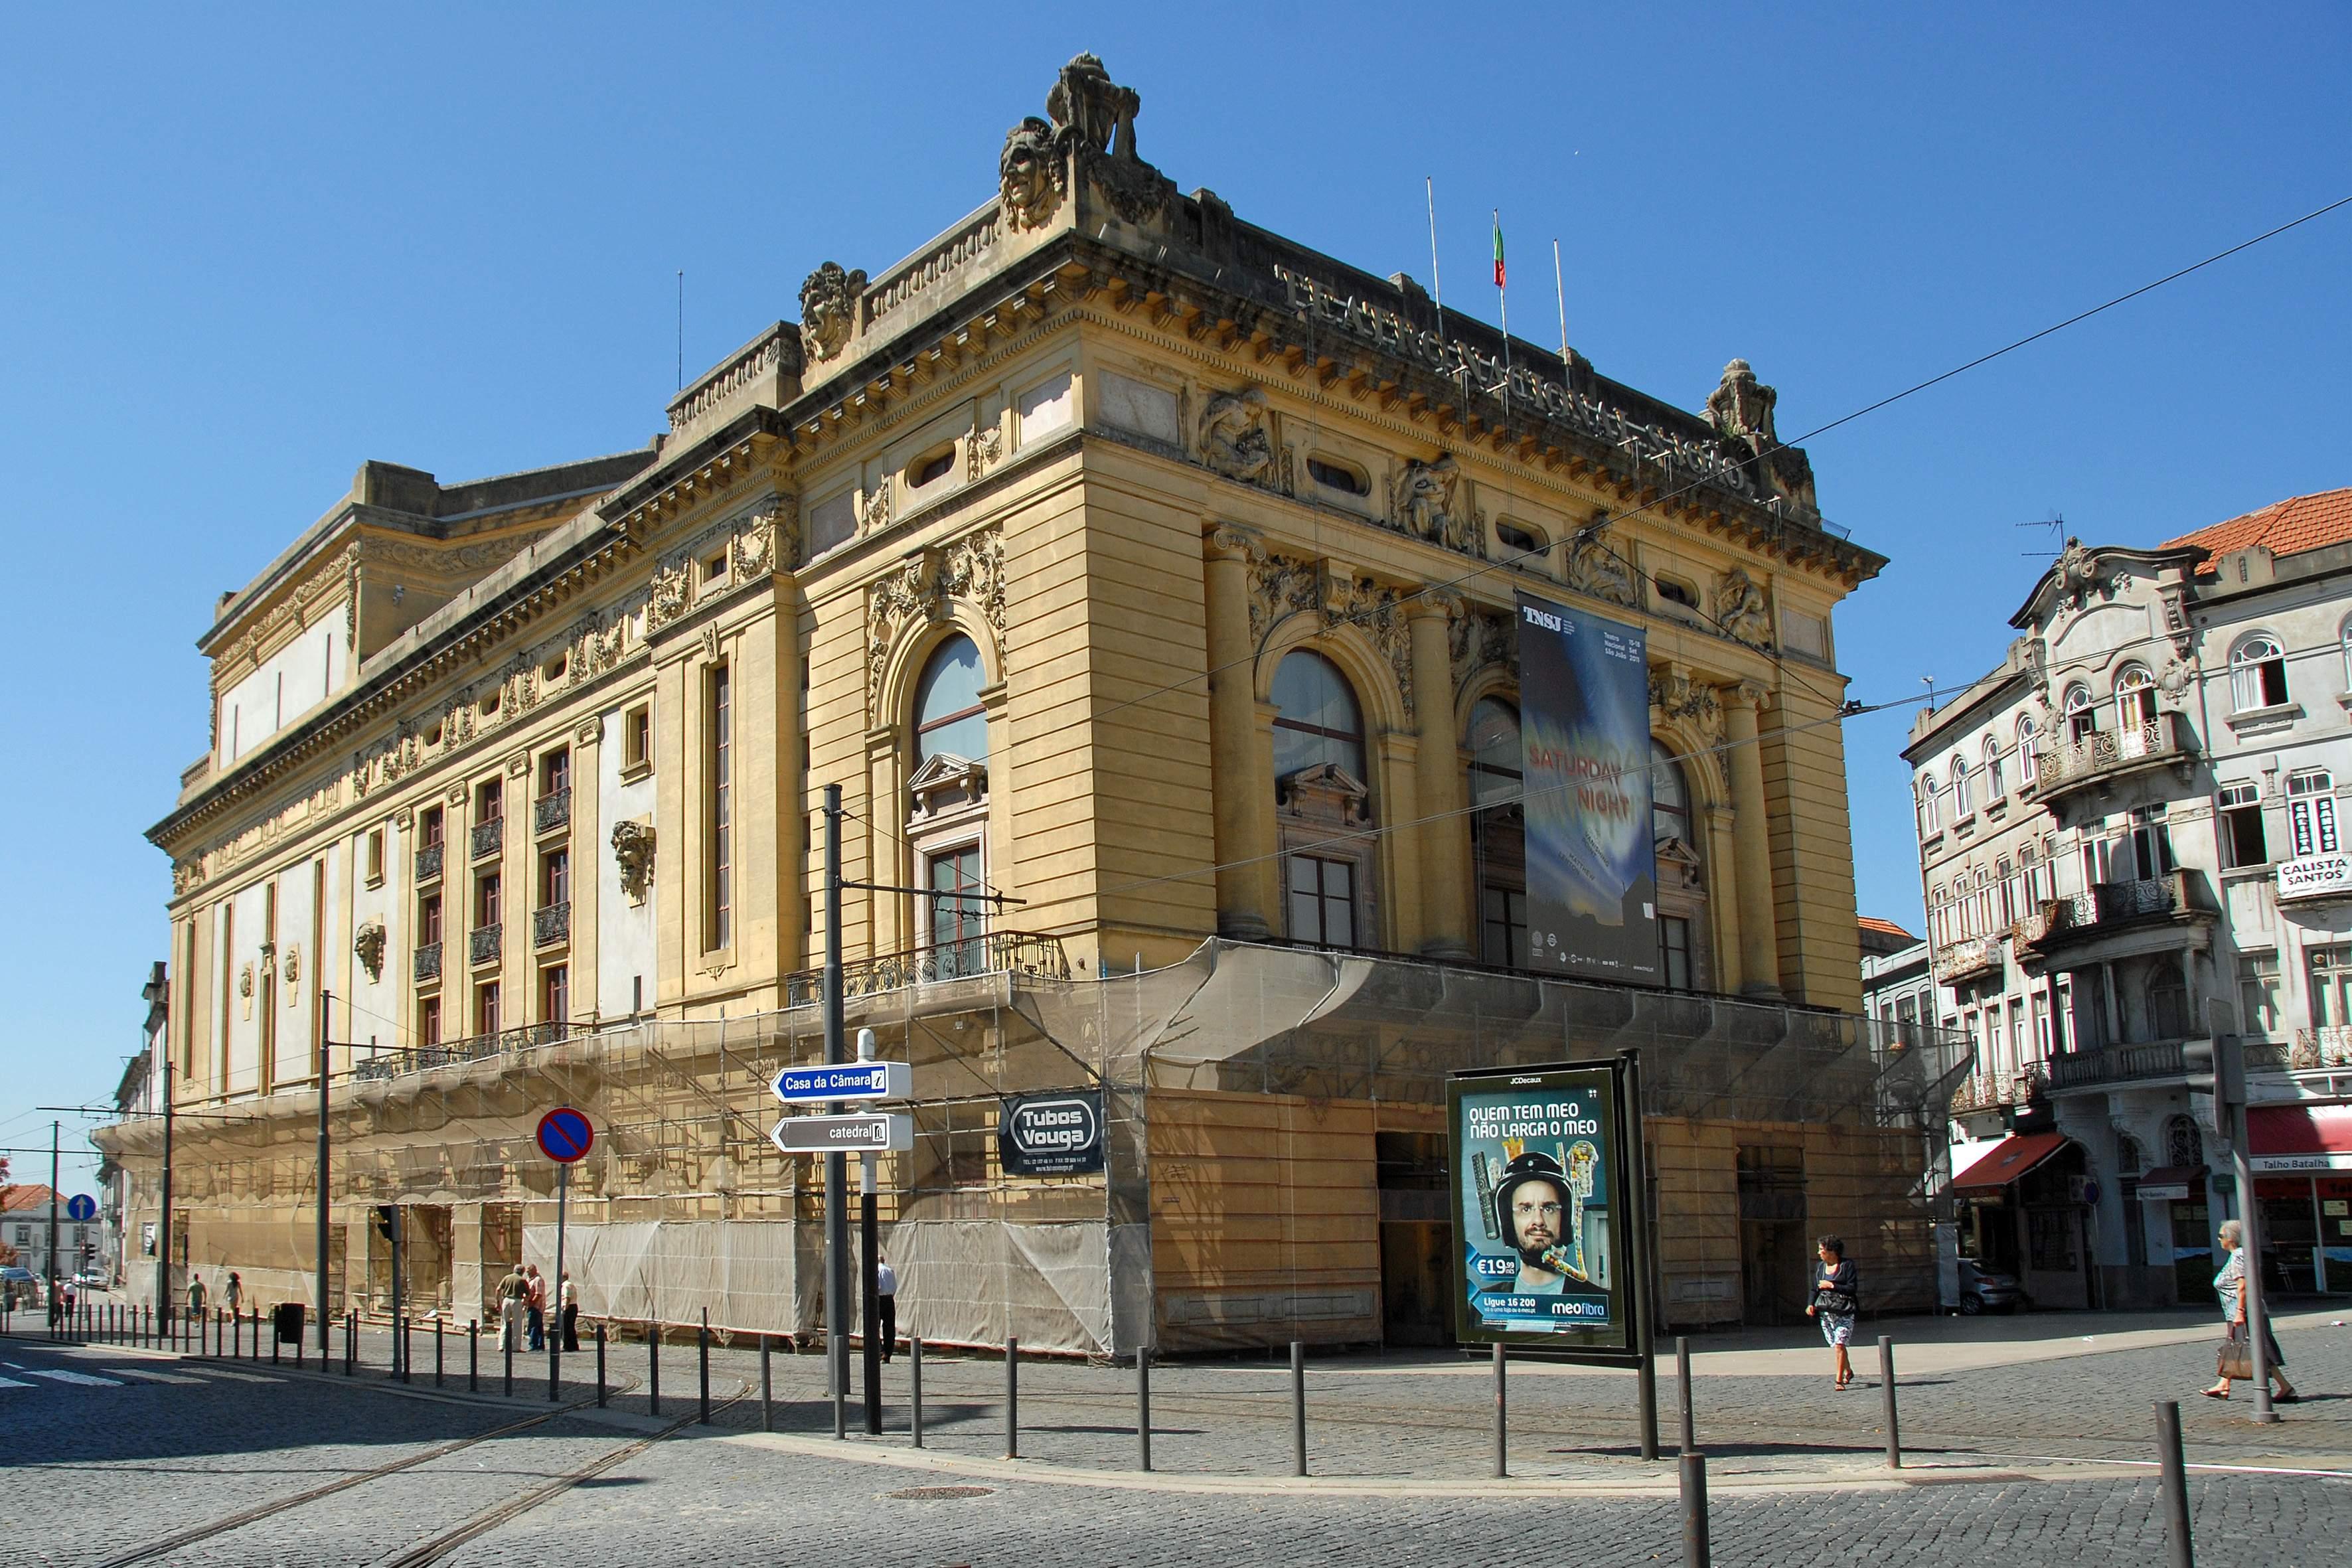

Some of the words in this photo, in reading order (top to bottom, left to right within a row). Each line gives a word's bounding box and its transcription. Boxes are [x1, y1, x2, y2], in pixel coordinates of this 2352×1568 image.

[1273, 264, 1449, 366] TEATRO
[1452, 339, 1637, 449] NACIONAL
[1523, 605, 1561, 632] TNSJ
[1604, 632, 1620, 642] Teatro
[1604, 640, 1626, 651] Nacional
[1529, 744, 1621, 785] SATURDAY
[1578, 787, 1630, 821] NIGHT
[2295, 805, 2312, 853] CALISTA
[2319, 801, 2335, 849] SANTOS
[2282, 859, 2348, 875] CALISTA
[2288, 870, 2343, 885] SANTOS
[785, 1077, 811, 1090] Casa
[814, 1075, 826, 1088] da
[830, 1074, 871, 1087] Câmara
[1022, 1109, 1083, 1127] Tubos
[1469, 1106, 1510, 1124] QUEM
[1512, 1105, 1543, 1119] TEM
[1546, 1103, 1579, 1118] MEO
[830, 1125, 872, 1138] catedral
[1470, 1121, 1498, 1138] NÃO
[1502, 1122, 1547, 1137] LARGA
[1550, 1121, 1560, 1136] O
[1564, 1119, 1597, 1135] MEO
[1022, 1129, 1083, 1148] Vouga
[1484, 1297, 1506, 1307] Ligue
[1508, 1298, 1518, 1306] 16
[1520, 1298, 1536, 1307] 200
